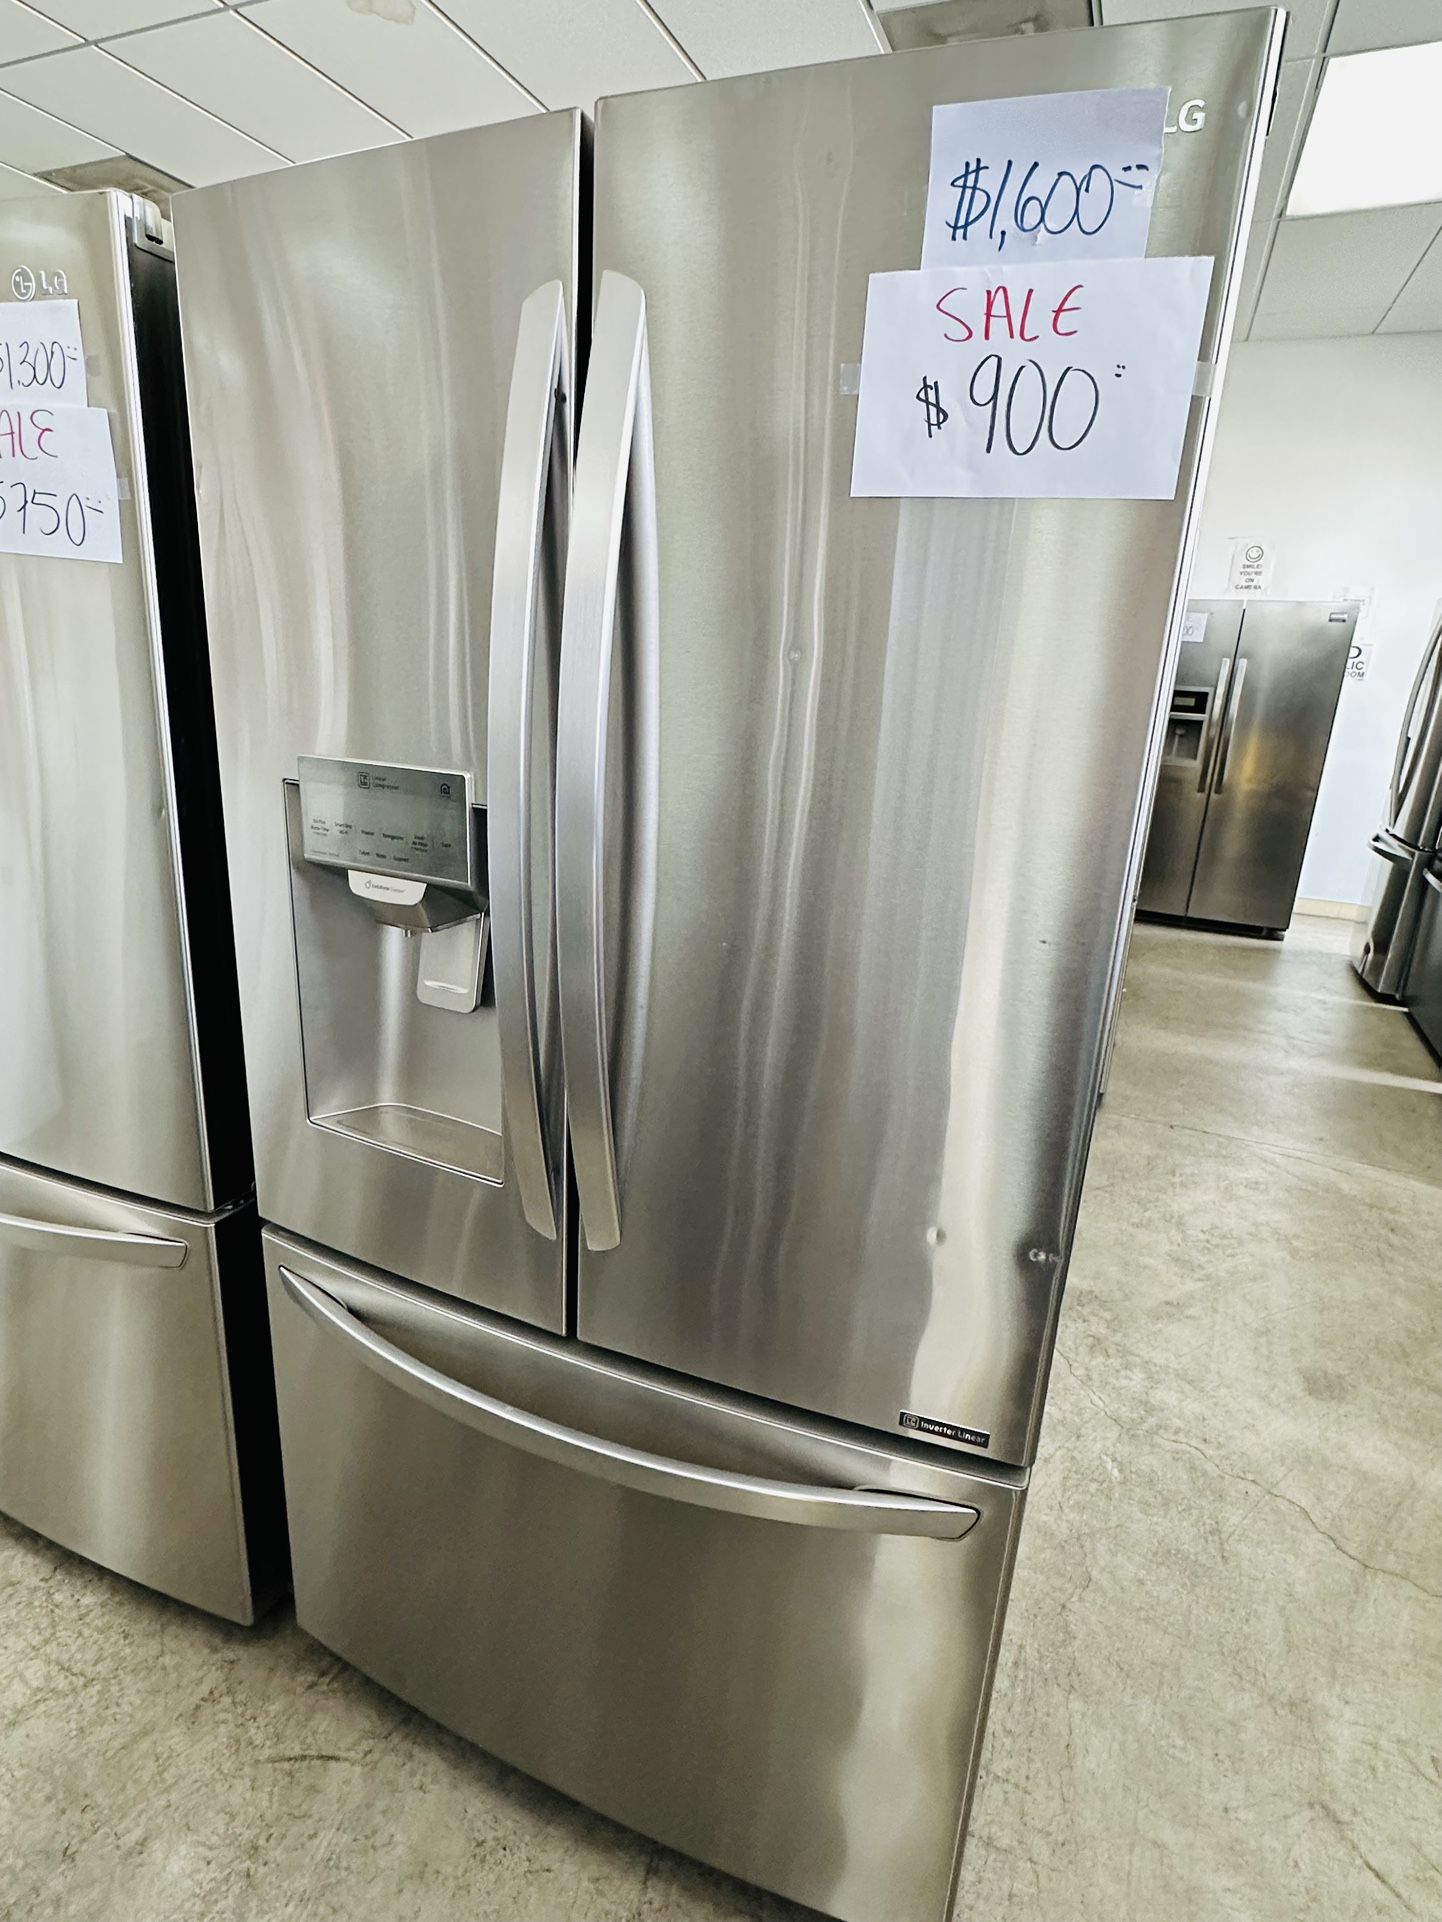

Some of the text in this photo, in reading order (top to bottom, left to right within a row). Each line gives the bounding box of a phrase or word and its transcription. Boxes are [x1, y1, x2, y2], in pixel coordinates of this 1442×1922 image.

[935, 284, 1085, 343] SALE
[0, 408, 59, 461] ALE
[920, 1421, 956, 1436] Inverter
[957, 1429, 985, 1443] Linear
